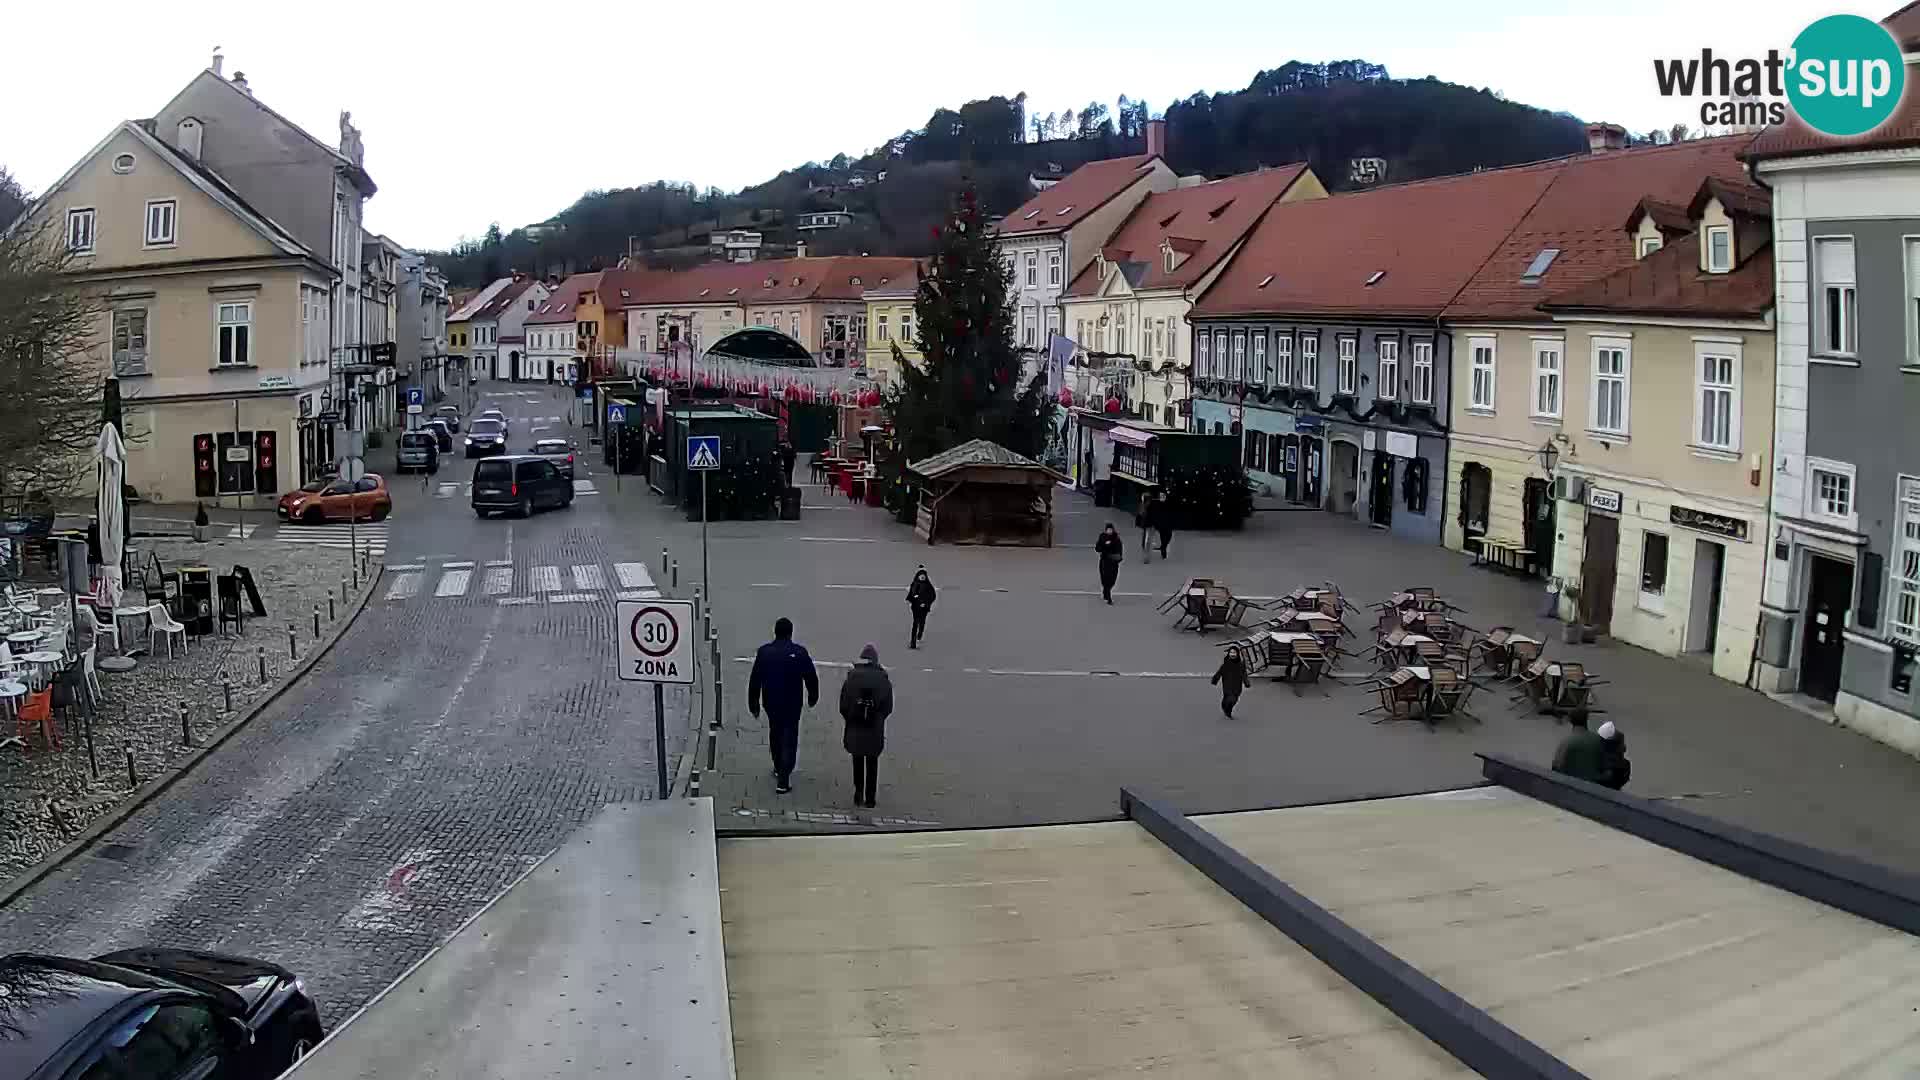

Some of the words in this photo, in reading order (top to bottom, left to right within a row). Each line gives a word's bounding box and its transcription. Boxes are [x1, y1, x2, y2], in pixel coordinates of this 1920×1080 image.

[411, 391, 419, 403] P
[643, 622, 667, 644] 30
[634, 659, 678, 676] ZONA
